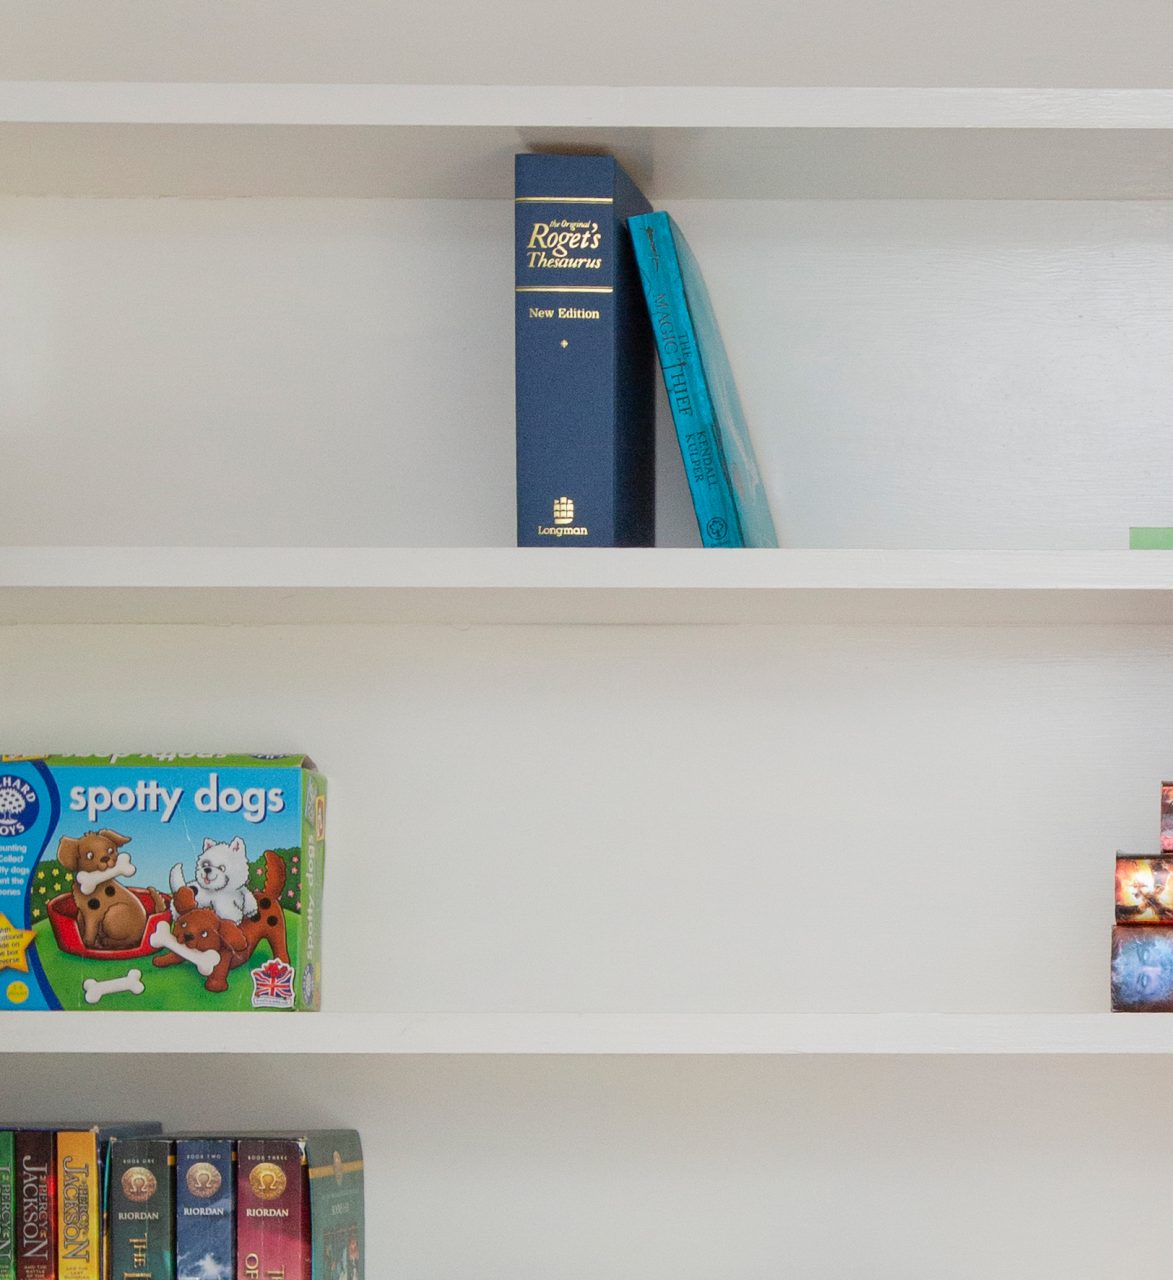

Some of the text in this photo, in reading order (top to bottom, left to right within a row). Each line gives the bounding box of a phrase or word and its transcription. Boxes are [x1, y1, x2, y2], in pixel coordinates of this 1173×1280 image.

[527, 222, 602, 258] Roget's
[561, 219, 591, 231] Original
[527, 251, 602, 269] Thesaurus
[529, 307, 600, 319] New Edition
[654, 292, 678, 355] MAGIC
[678, 334, 691, 358] THE
[662, 360, 693, 417] THIEF
[696, 431, 719, 489] KENDALL
[538, 525, 588, 537] Longman
[69, 779, 184, 823] spotty
[194, 772, 286, 823] dogs
[23, 1154, 49, 1261] JACKSON
[39, 1184, 49, 1231] PERCY
[62, 1155, 91, 1263] JACKSON
[118, 1212, 160, 1221] RIORDAN
[183, 1207, 225, 1216] RIORDAN
[246, 1208, 289, 1217] RIORDAN
[128, 1232, 148, 1268] THE
[245, 1253, 259, 1280] OF
